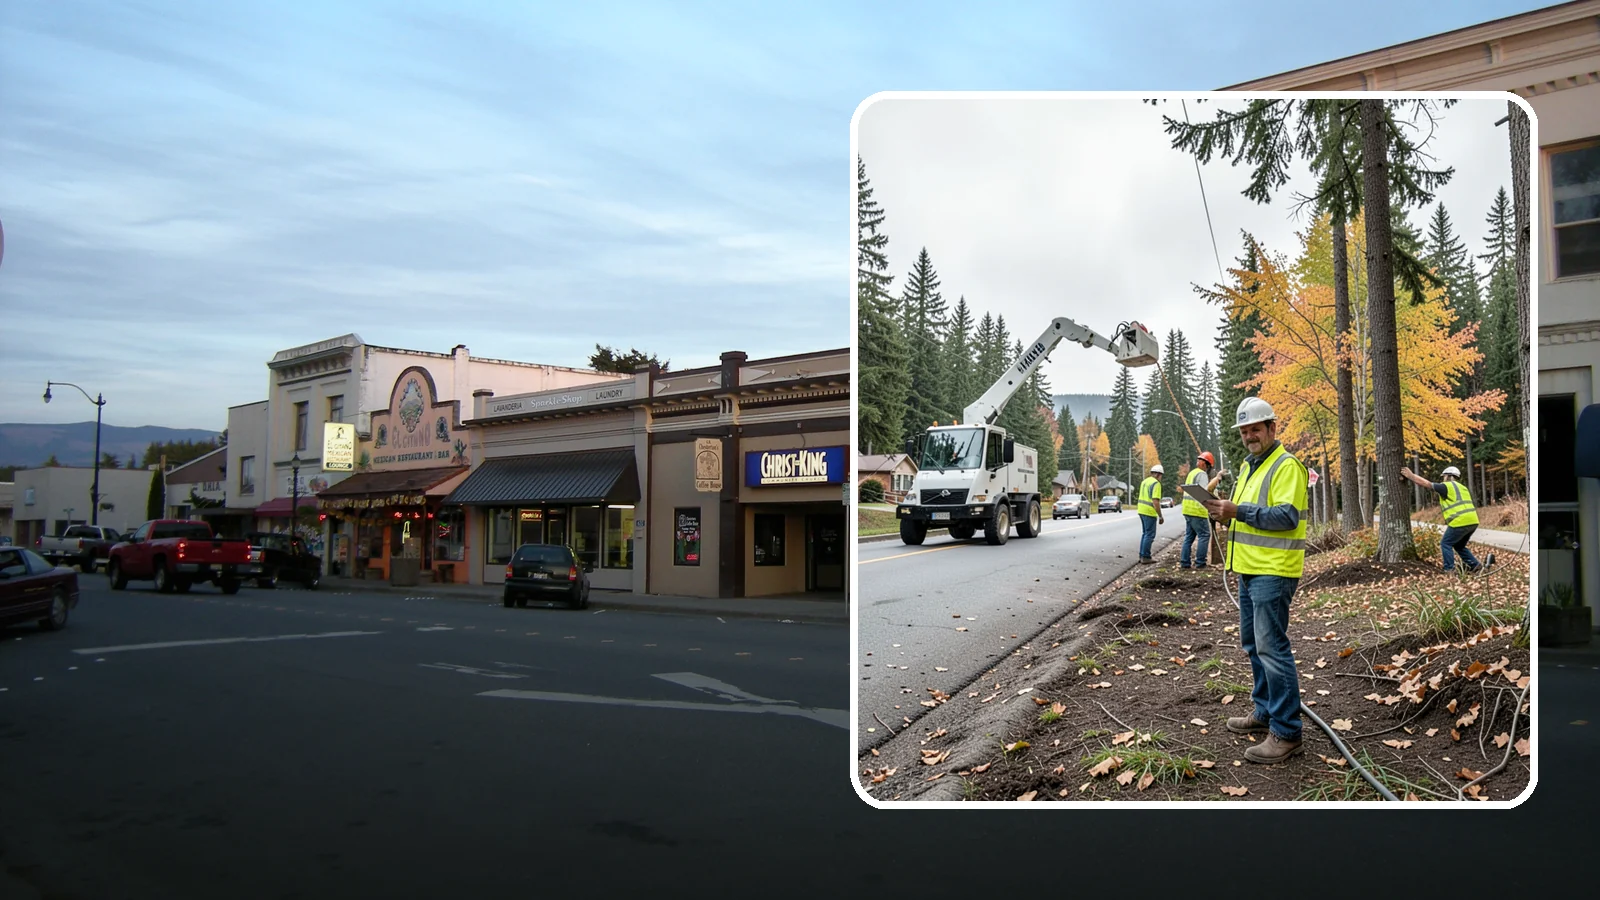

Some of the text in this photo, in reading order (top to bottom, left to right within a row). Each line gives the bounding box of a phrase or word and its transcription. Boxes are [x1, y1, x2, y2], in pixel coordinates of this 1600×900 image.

[493, 402, 522, 412] LAVANDERIA
[562, 394, 582, 405] Shop
[596, 389, 623, 400] LAUNDRY
[373, 450, 450, 464] MEXICAN RESTAURANT BAR
[761, 450, 827, 478] CHRIST KING
[697, 481, 722, 489] Coffee House
